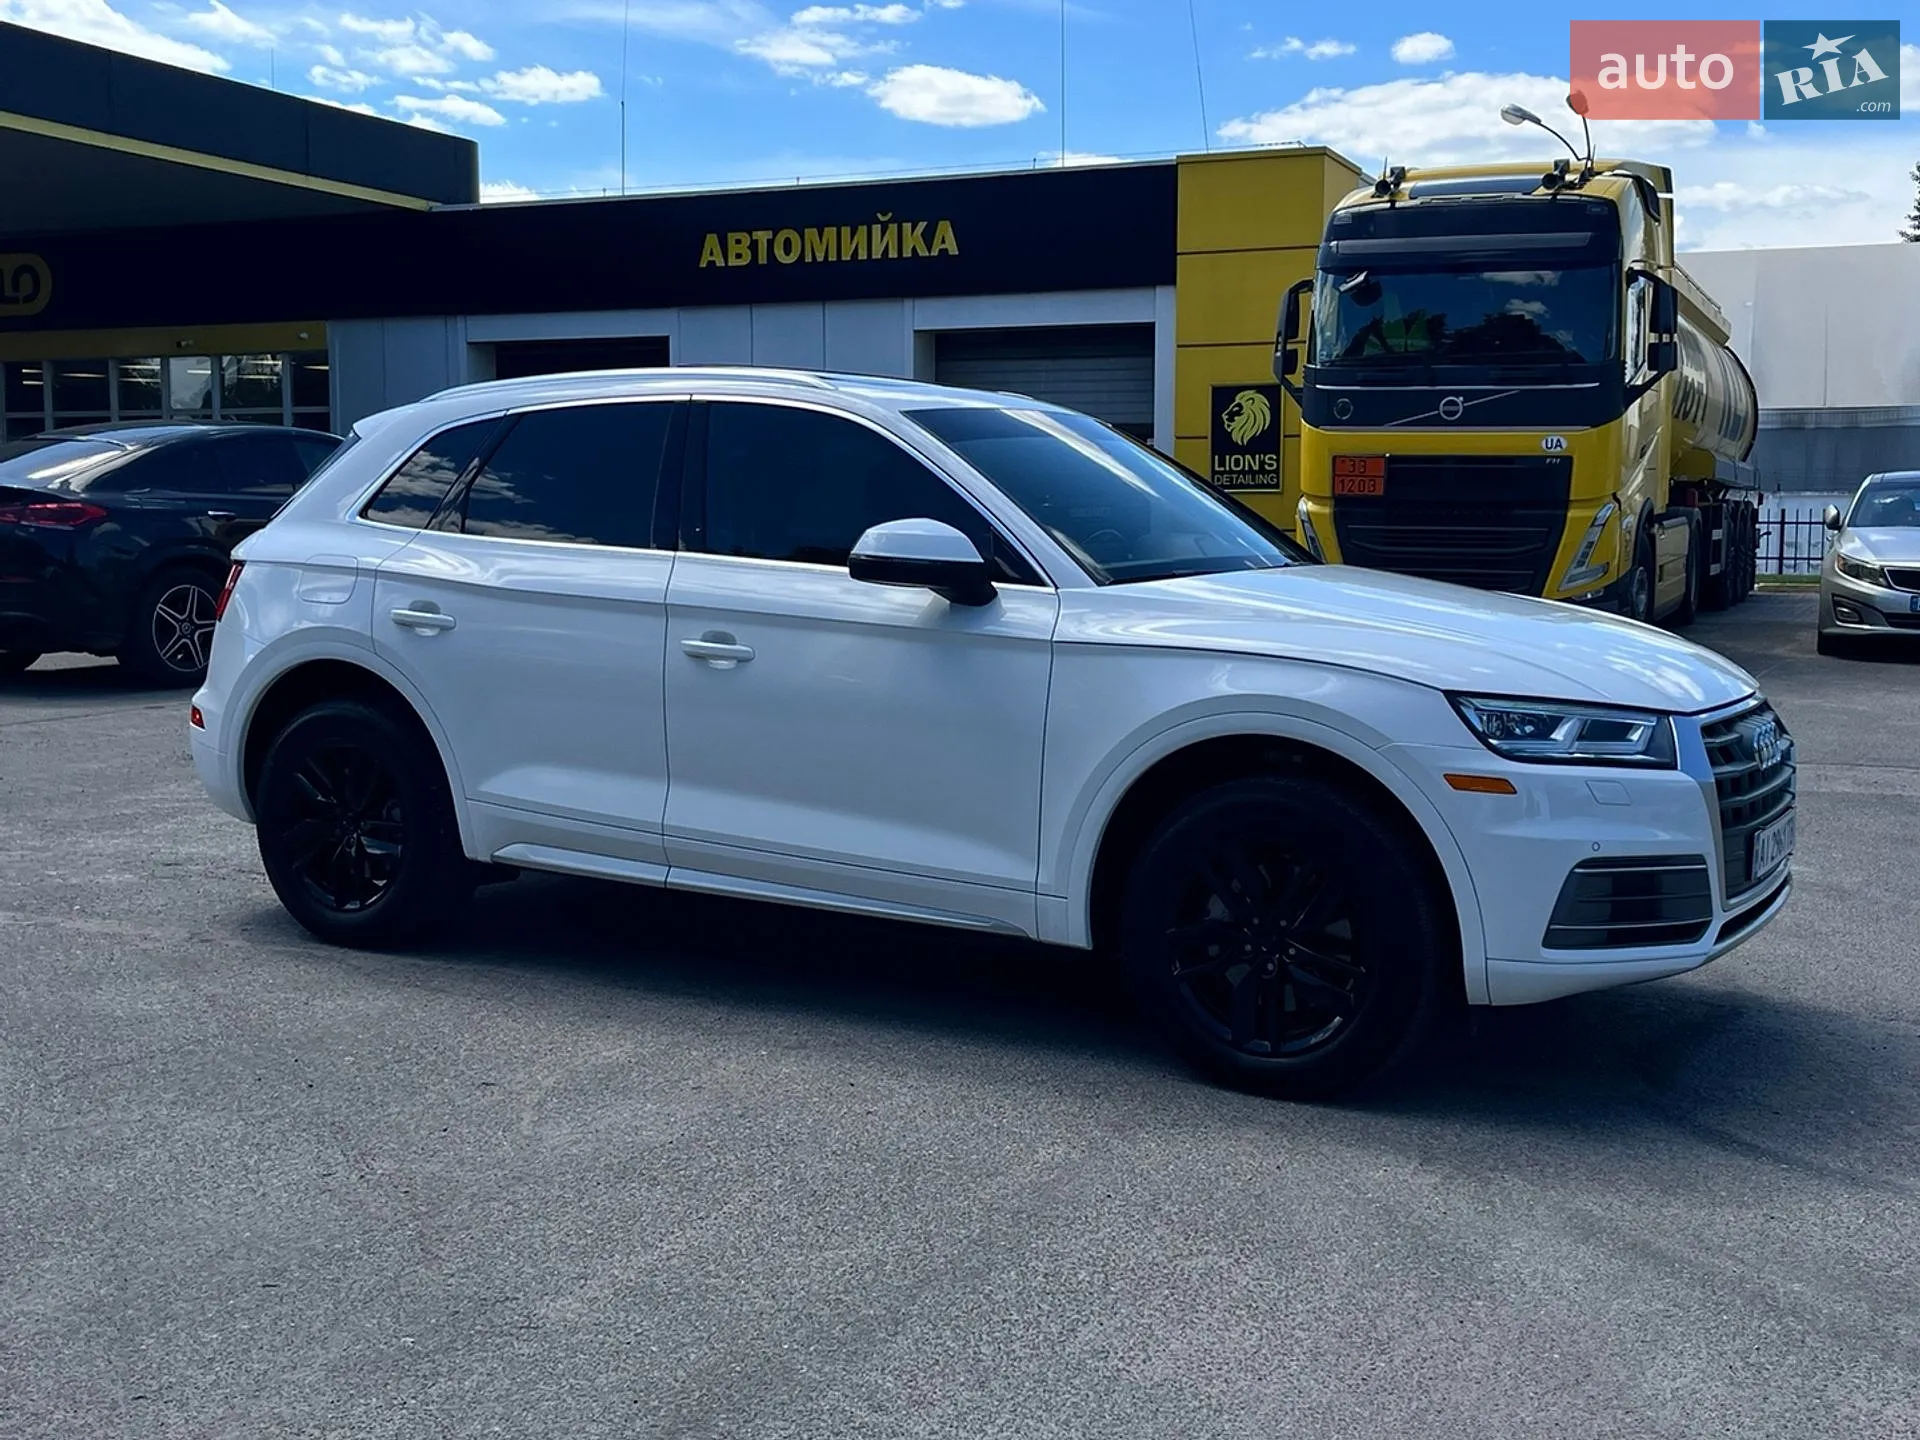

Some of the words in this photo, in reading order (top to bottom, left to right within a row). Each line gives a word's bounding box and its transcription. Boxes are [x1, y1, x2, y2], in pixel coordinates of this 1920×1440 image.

[699, 212, 959, 268] АВТОМИЙКА
[1545, 437, 1564, 450] UA
[1214, 454, 1277, 471] LION'S
[1347, 459, 1367, 474] 33
[1214, 474, 1277, 485] DETAILING
[1338, 478, 1377, 494] 1203
